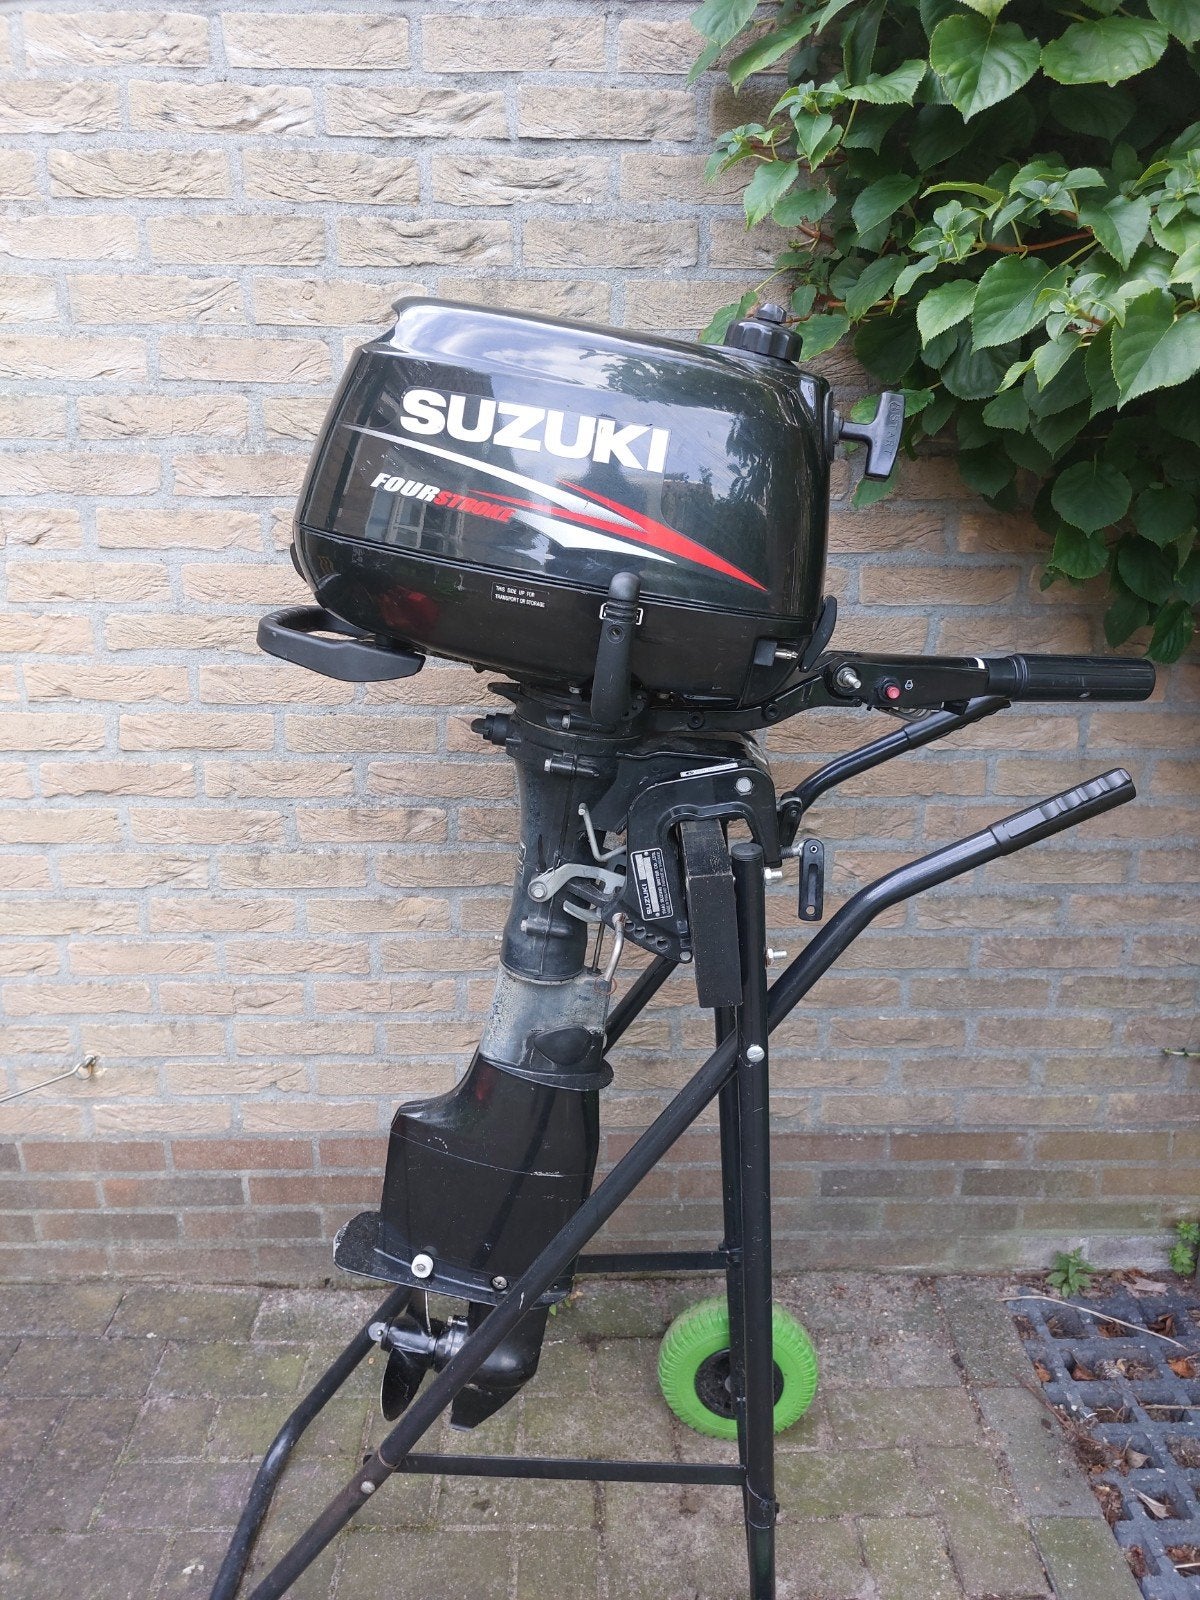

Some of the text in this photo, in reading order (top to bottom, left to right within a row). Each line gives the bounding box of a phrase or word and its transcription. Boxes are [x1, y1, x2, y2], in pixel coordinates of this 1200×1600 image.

[400, 389, 671, 474] SUZUKI
[883, 413, 900, 456] START
[495, 594, 519, 602] TRANSPORT
[642, 884, 652, 914] SUZUKI
